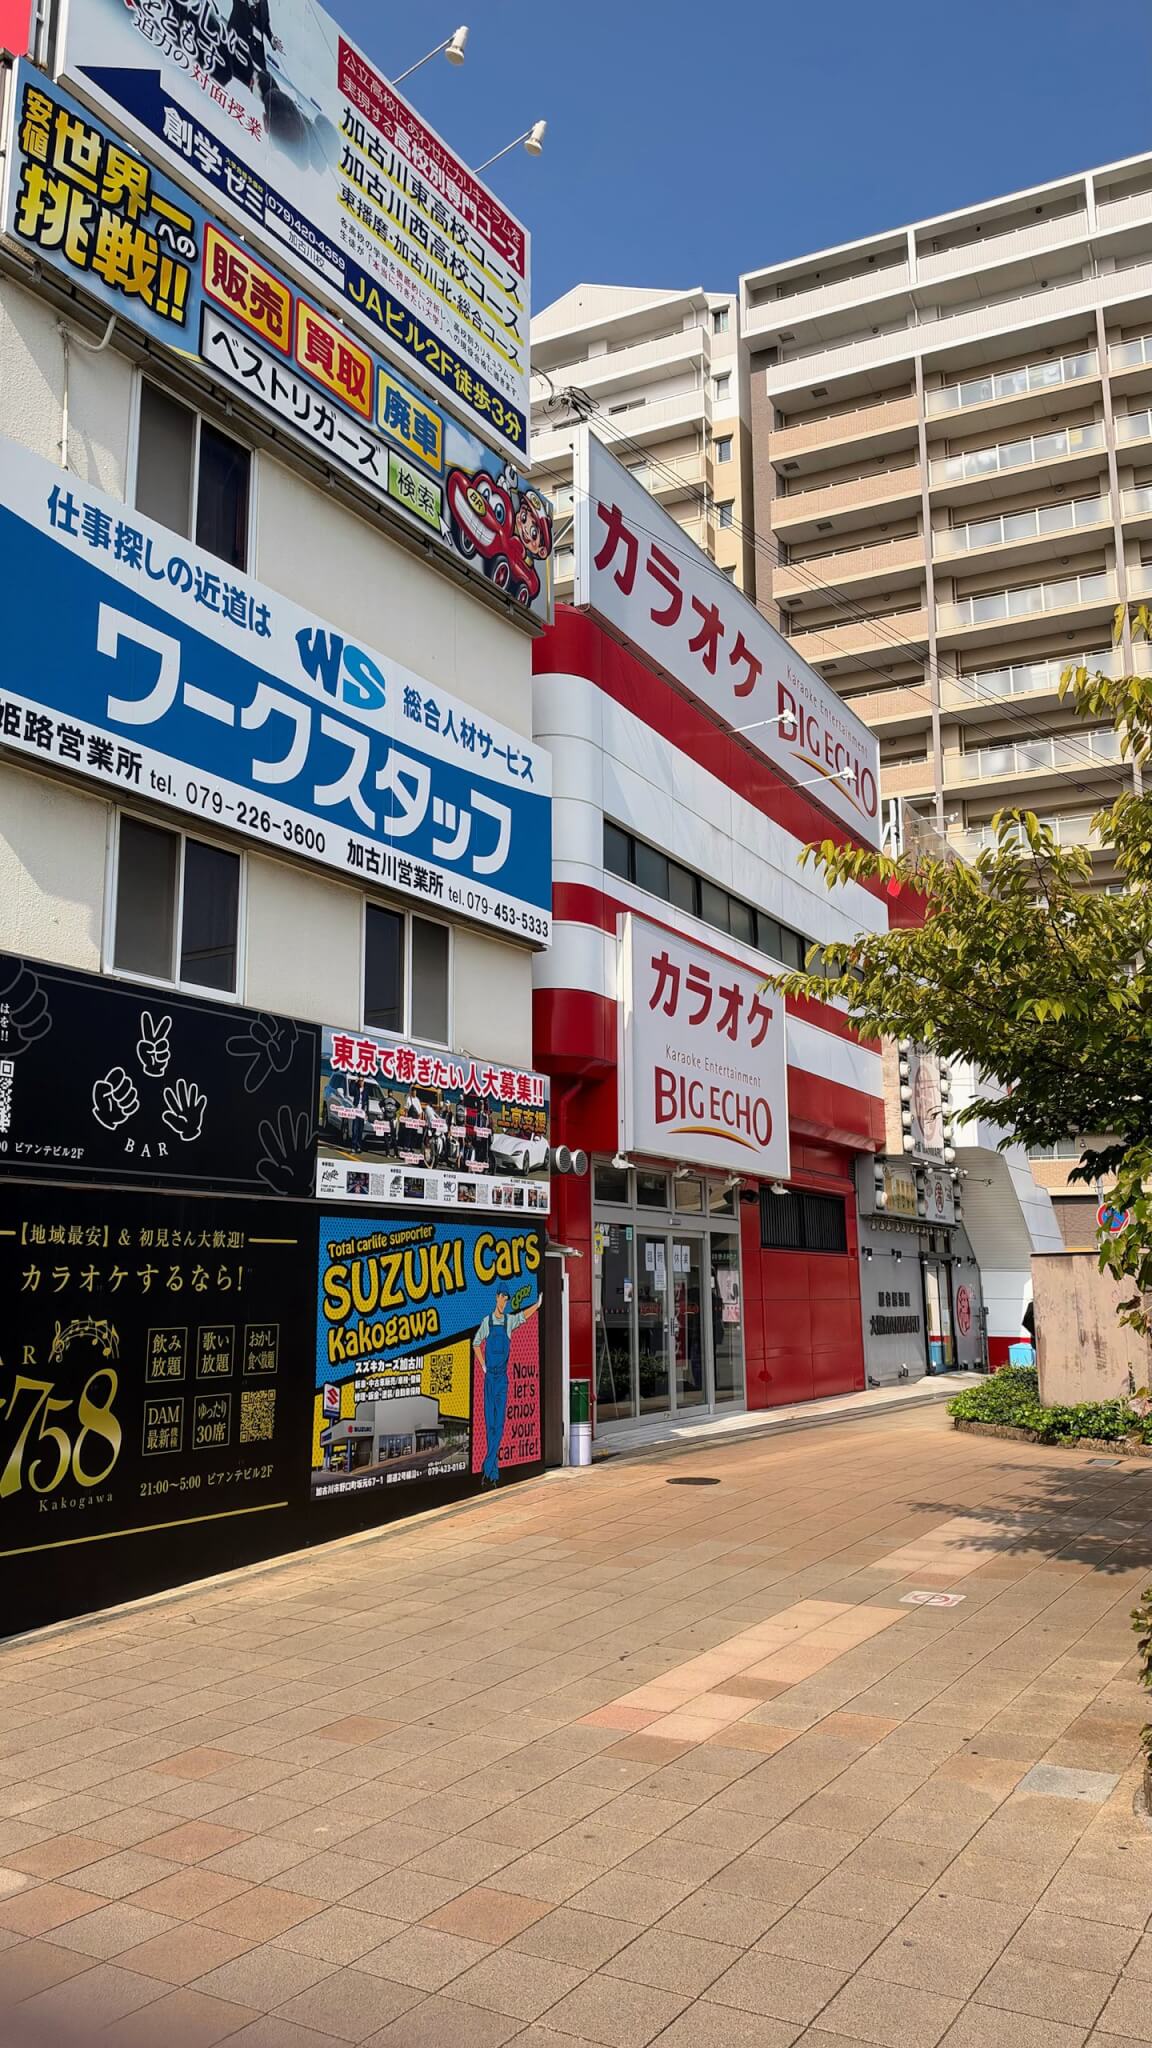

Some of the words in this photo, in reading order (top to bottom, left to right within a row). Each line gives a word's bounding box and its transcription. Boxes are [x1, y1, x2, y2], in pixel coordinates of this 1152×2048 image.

[343, 74, 521, 271] 実現する高校別専門コース
[344, 49, 521, 247] 公立高校にあわせたカリキュラムを
[341, 145, 520, 339] 加古川西高校コース
[342, 106, 520, 304] 加古川東高校コース
[213, 242, 284, 337] 販売
[306, 318, 366, 405] 買取
[349, 277, 522, 442] JAビル2F徒歩3分
[213, 330, 381, 477] ベストリガーズ
[384, 386, 438, 458] 廃車
[398, 467, 436, 519] 検索
[47, 484, 272, 639] 仕事探しの近道は
[593, 500, 763, 698] カラオケ
[295, 627, 386, 711] WS
[787, 665, 817, 704] Karaoke
[819, 698, 868, 759] Entertainment
[0, 702, 143, 785] 姫路営業所
[150, 769, 178, 797] tel.
[186, 782, 326, 853] 079-226-3600
[97, 601, 512, 875] ワークスタッフ
[403, 685, 534, 783] 総合人材サービス
[347, 838, 443, 899] 加古川営業所
[467, 891, 549, 938] 079-453-5333
[649, 951, 773, 1049] カラオケ
[332, 1034, 544, 1105] 東京で稼ぎたい人大募集!!
[655, 1066, 704, 1124] BIG
[710, 1087, 773, 1147] ECHO
[666, 1043, 701, 1070] Karaoke
[704, 1057, 761, 1088] Entertainment
[498, 1107, 546, 1132] 上京支援
[21, 1263, 243, 1293] カラオケするなら!
[324, 1240, 464, 1321] SUZUKI
[474, 1233, 541, 1281] Cars
[328, 1241, 355, 1259] Total
[357, 1233, 387, 1253] carlife
[390, 1225, 433, 1246] supporter
[151, 1356, 182, 1377] 放題
[152, 1334, 182, 1354] 飲み
[328, 1307, 438, 1362] Kakogawa
[355, 1355, 424, 1374] スズキカーズ加古川
[0, 1368, 122, 1498] 758
[148, 1405, 180, 1426] DAM
[507, 1402, 536, 1419] enjoy
[511, 1422, 536, 1439] your
[39, 1493, 113, 1513] Kakogawa
